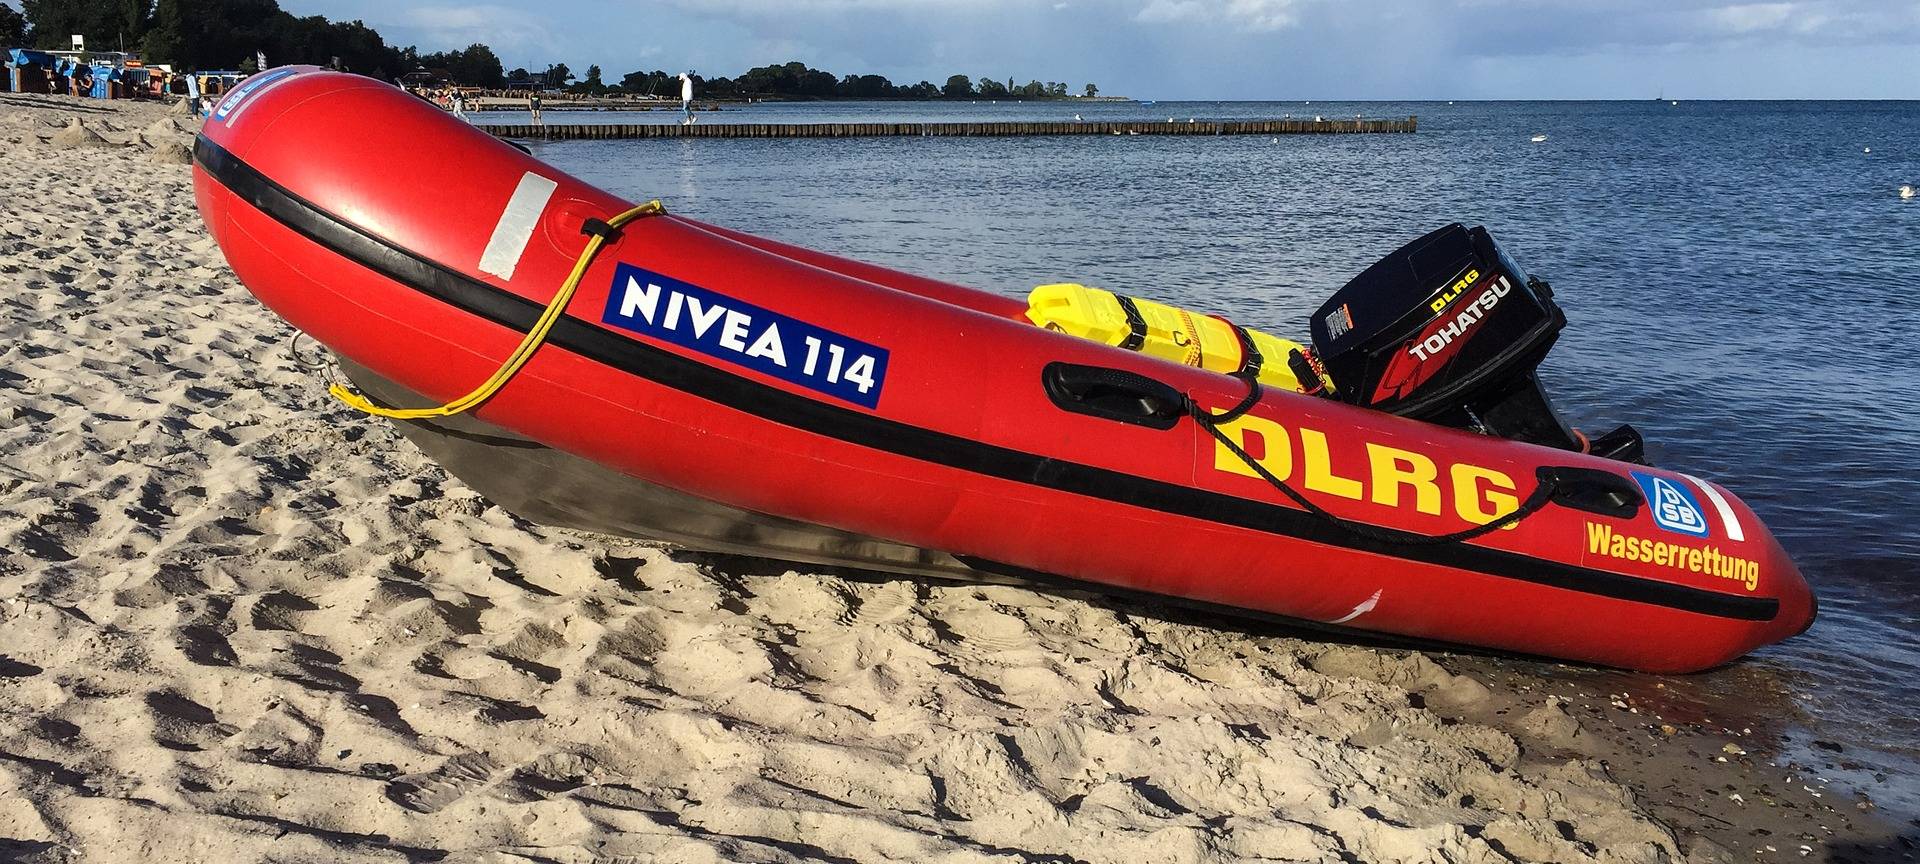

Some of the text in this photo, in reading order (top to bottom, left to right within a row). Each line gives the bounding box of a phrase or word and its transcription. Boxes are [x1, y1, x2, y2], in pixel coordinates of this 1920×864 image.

[1408, 276, 1512, 361] TOHATSU
[1430, 269, 1480, 313] DLRG
[619, 275, 876, 394] NIVEA 114
[1210, 406, 1520, 531] DLRG
[1587, 521, 1759, 592] Wasserrettung
